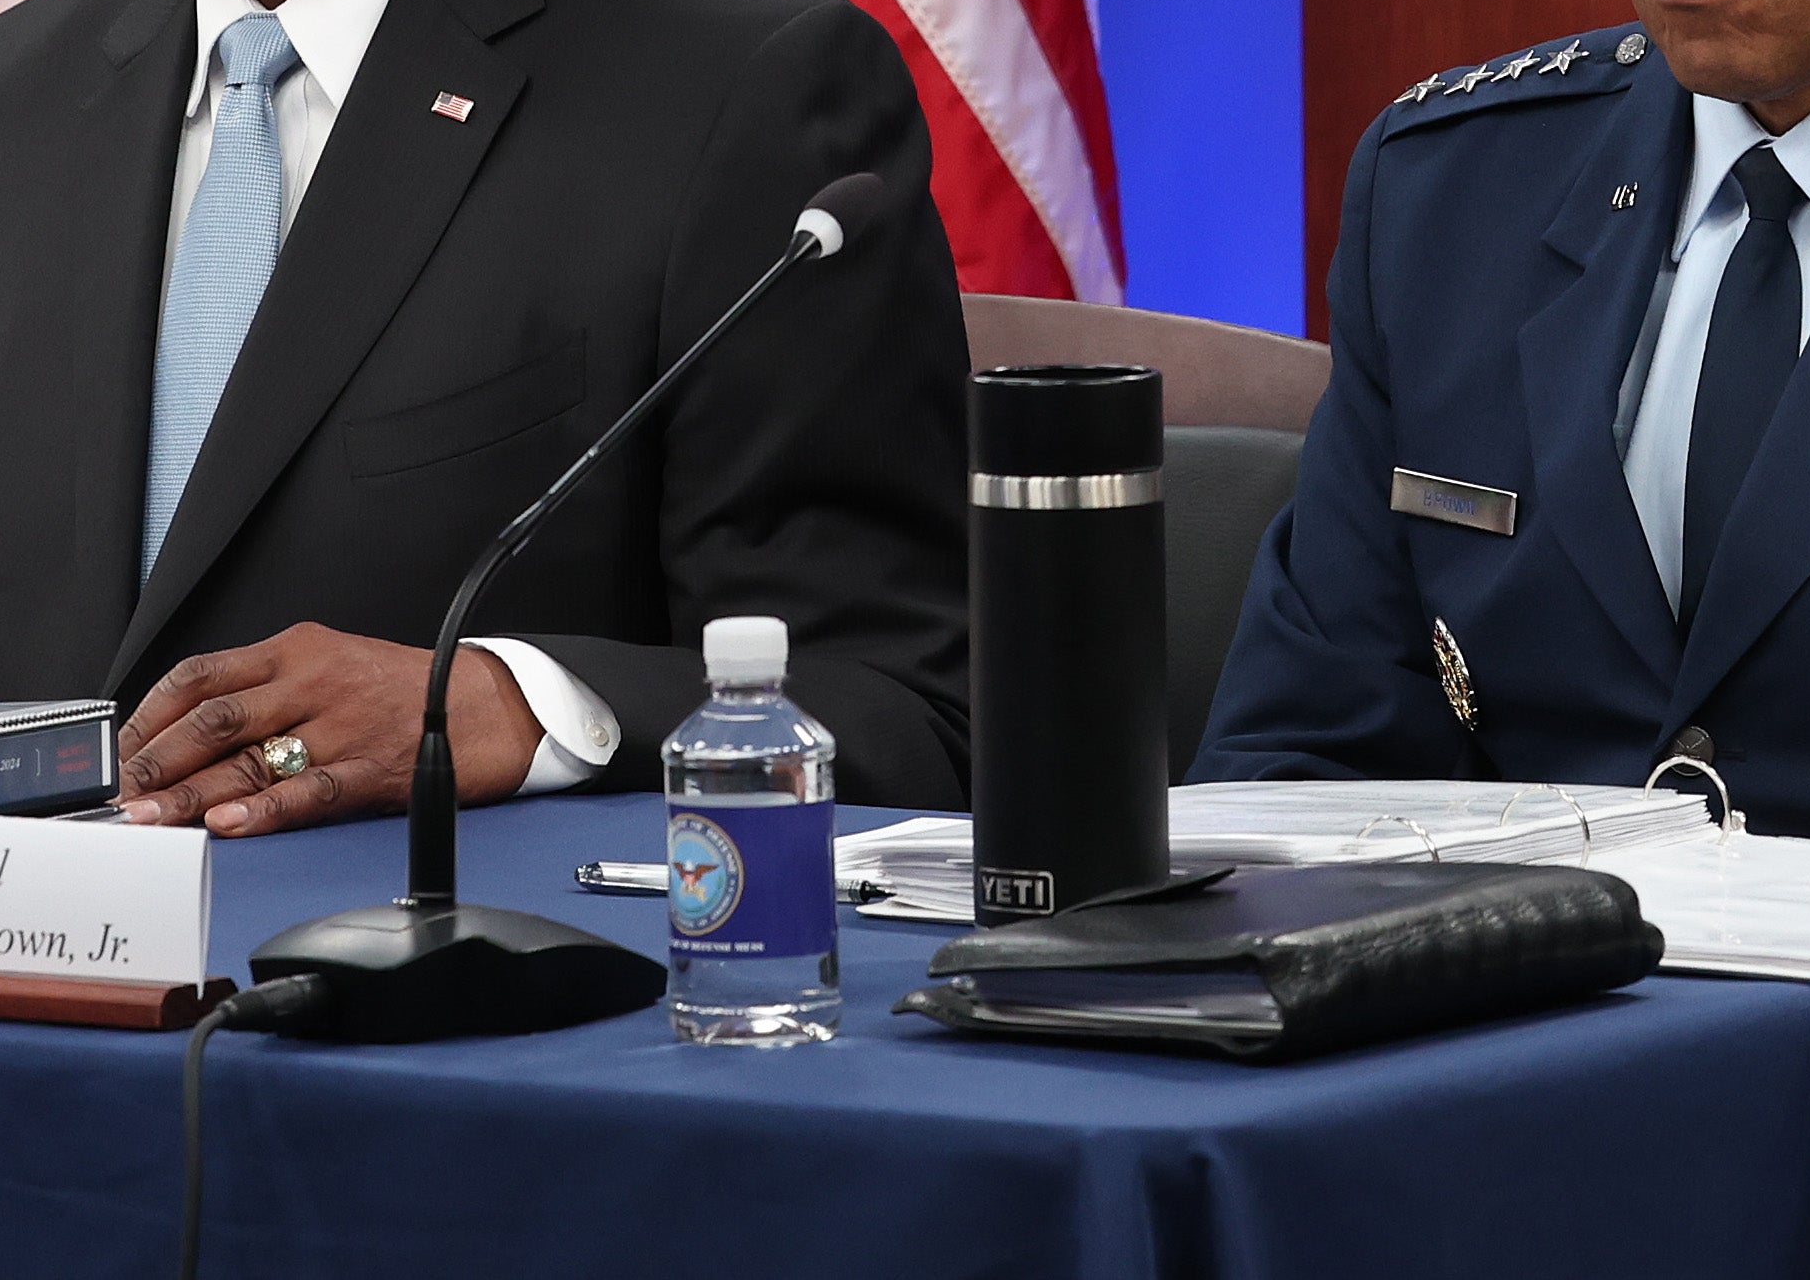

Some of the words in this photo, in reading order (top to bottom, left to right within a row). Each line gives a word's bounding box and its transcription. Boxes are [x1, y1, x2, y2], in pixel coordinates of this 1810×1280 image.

[0, 757, 22, 773] 2024
[982, 874, 1045, 907] YETI
[87, 922, 130, 964] Jr.
